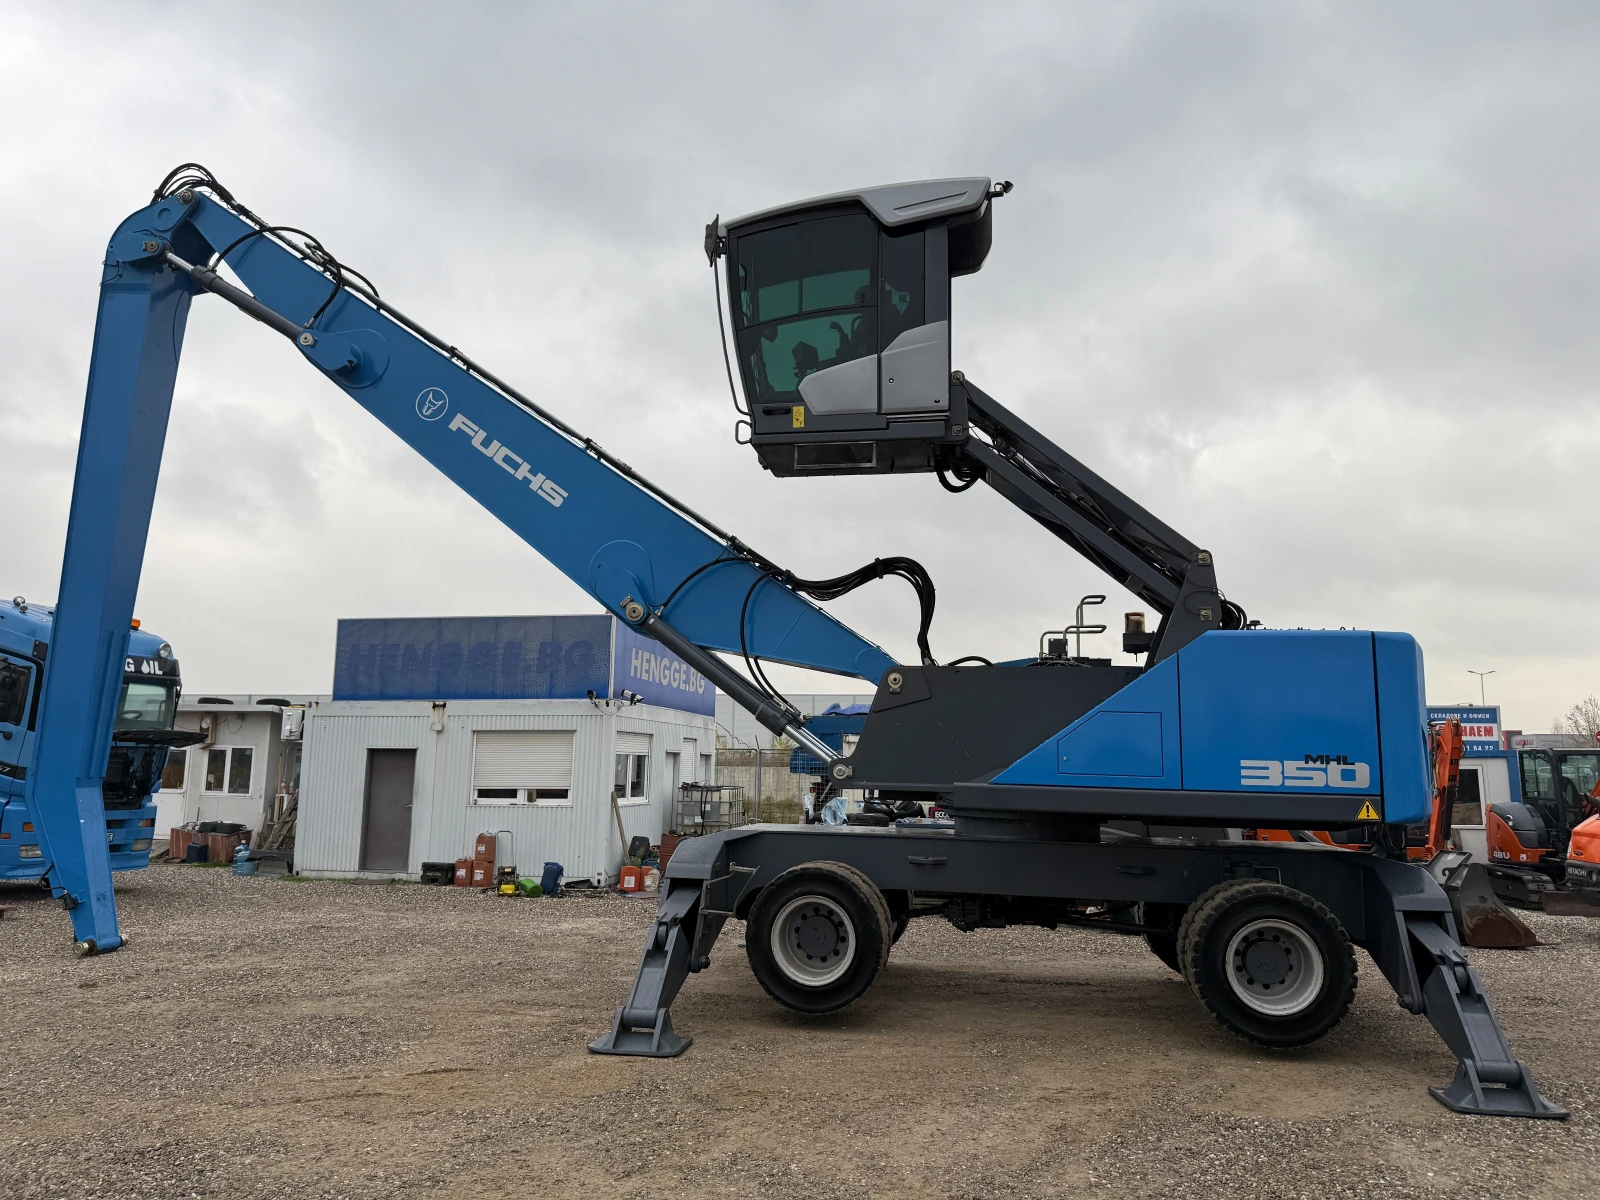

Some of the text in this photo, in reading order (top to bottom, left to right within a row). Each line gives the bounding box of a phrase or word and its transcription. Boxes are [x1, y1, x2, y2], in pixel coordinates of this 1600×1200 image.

[448, 412, 569, 508] FUCHS
[630, 647, 706, 695] HENGGE.BG
[1304, 754, 1355, 765] MHL
[1240, 759, 1370, 789] 350
[1493, 851, 1510, 860] 48U
[1567, 868, 1587, 877] HITACHI
